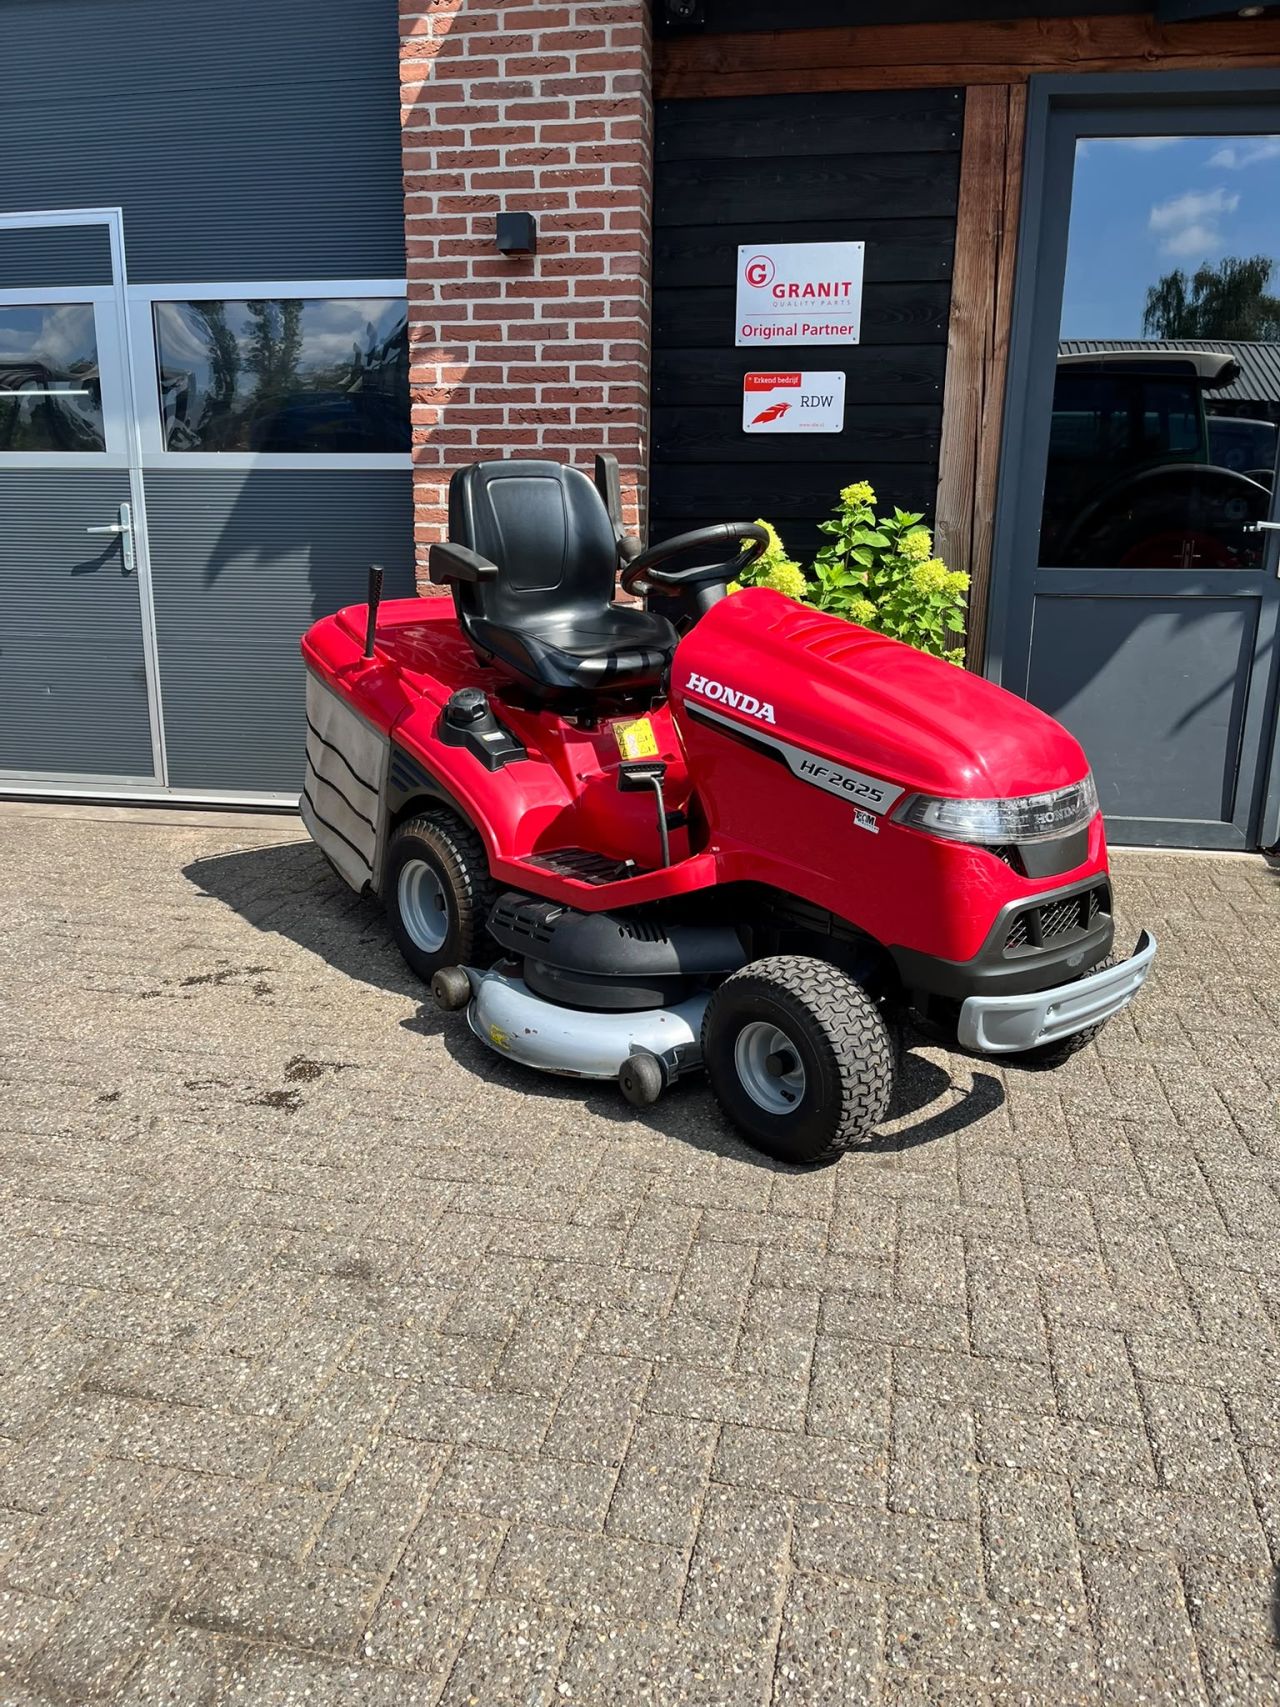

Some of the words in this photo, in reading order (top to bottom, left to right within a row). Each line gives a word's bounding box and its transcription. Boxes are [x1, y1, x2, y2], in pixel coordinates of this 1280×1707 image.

[747, 264, 767, 285] G
[772, 282, 852, 299] GRANIT
[742, 323, 797, 340] Original
[802, 323, 854, 336] Partner
[753, 376, 777, 384] Erkend
[777, 376, 799, 385] bedrijf
[800, 395, 834, 408] RDW
[685, 672, 777, 725] HONDA
[799, 759, 829, 778] HF
[828, 771, 886, 803] 2625
[1034, 804, 1081, 824] HONDA
